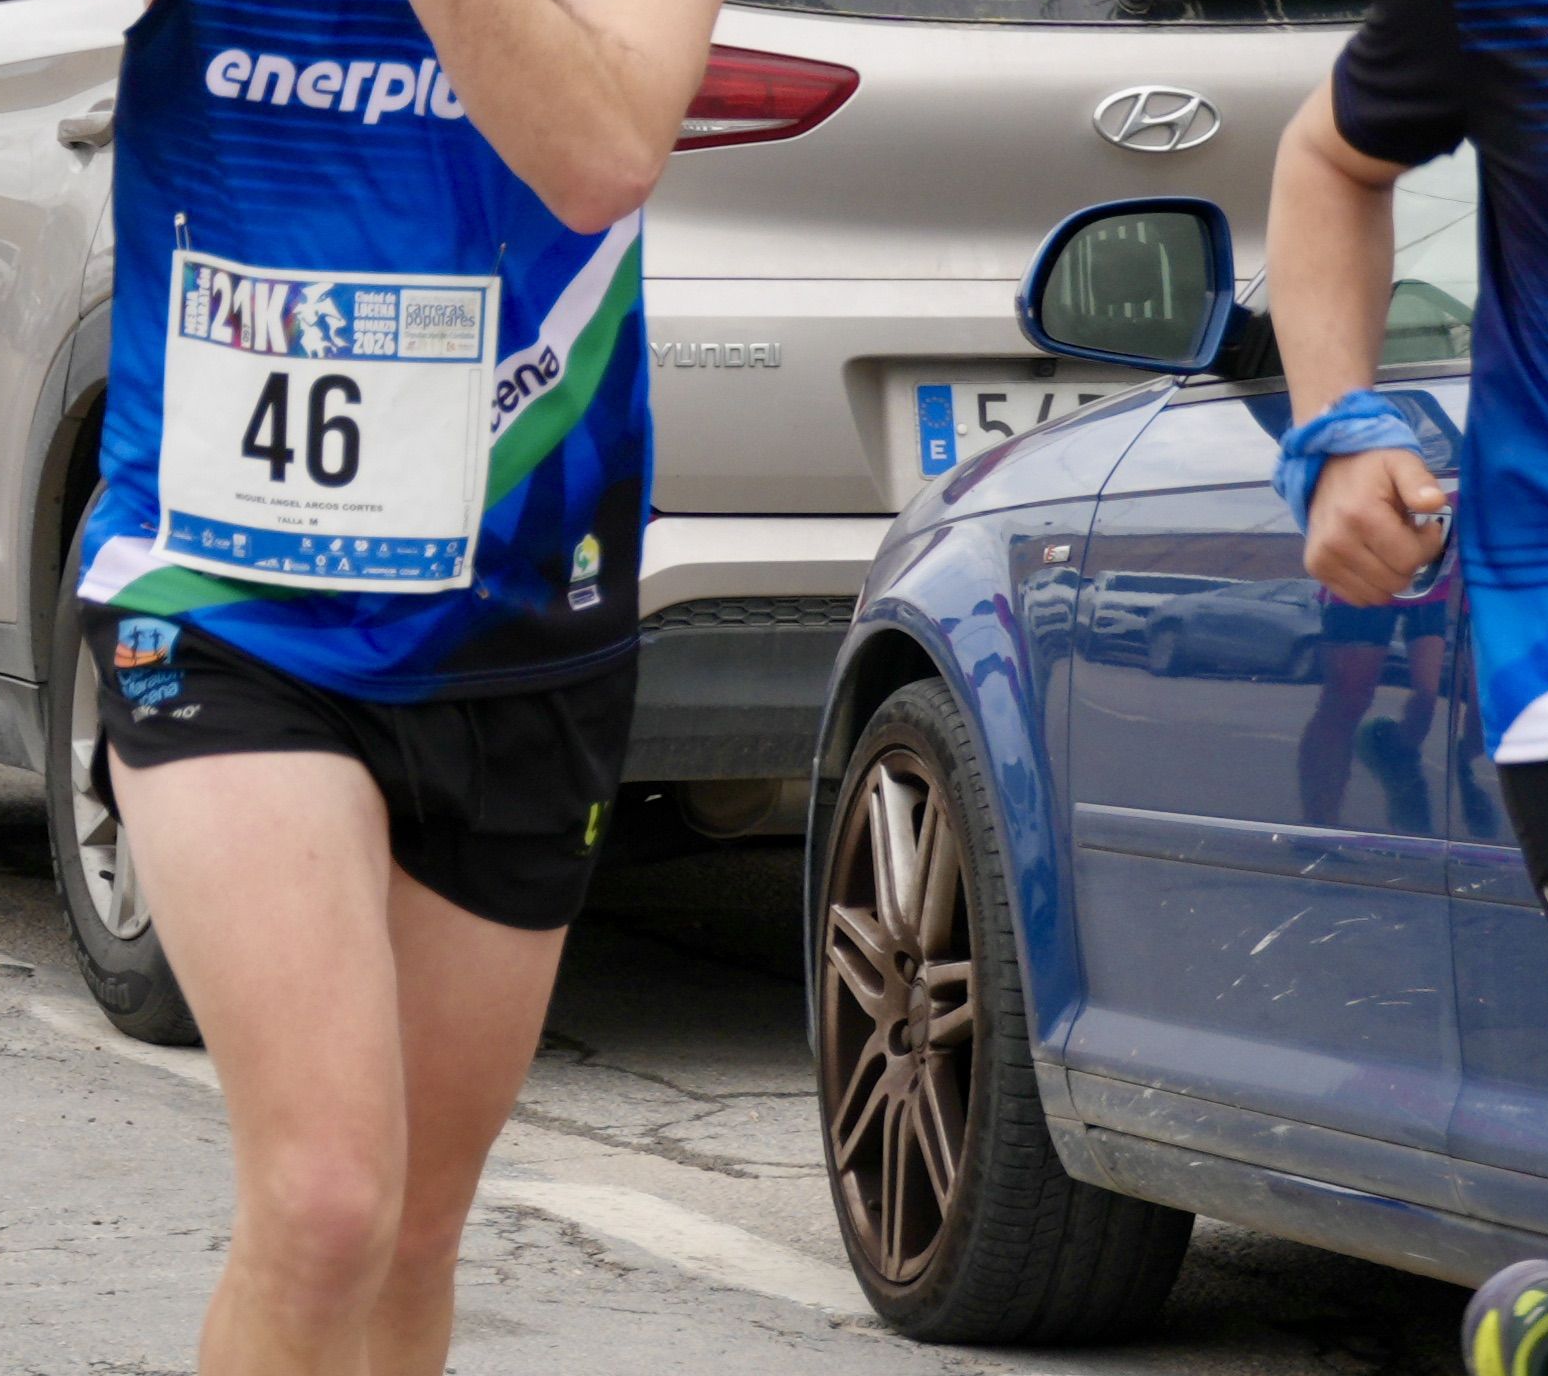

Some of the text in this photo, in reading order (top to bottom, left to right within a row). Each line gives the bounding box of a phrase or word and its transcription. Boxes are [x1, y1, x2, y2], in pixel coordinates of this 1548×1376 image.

[205, 48, 466, 125] enerplu
[210, 271, 289, 353] 21K
[405, 311, 476, 330] populares
[406, 303, 465, 316] carreras
[352, 332, 397, 355] 2026
[650, 341, 782, 368] YUNDAI
[241, 371, 362, 488] 46
[929, 439, 947, 461] E
[235, 492, 384, 513] MIGUEL ANGEL ARCOS CORTES
